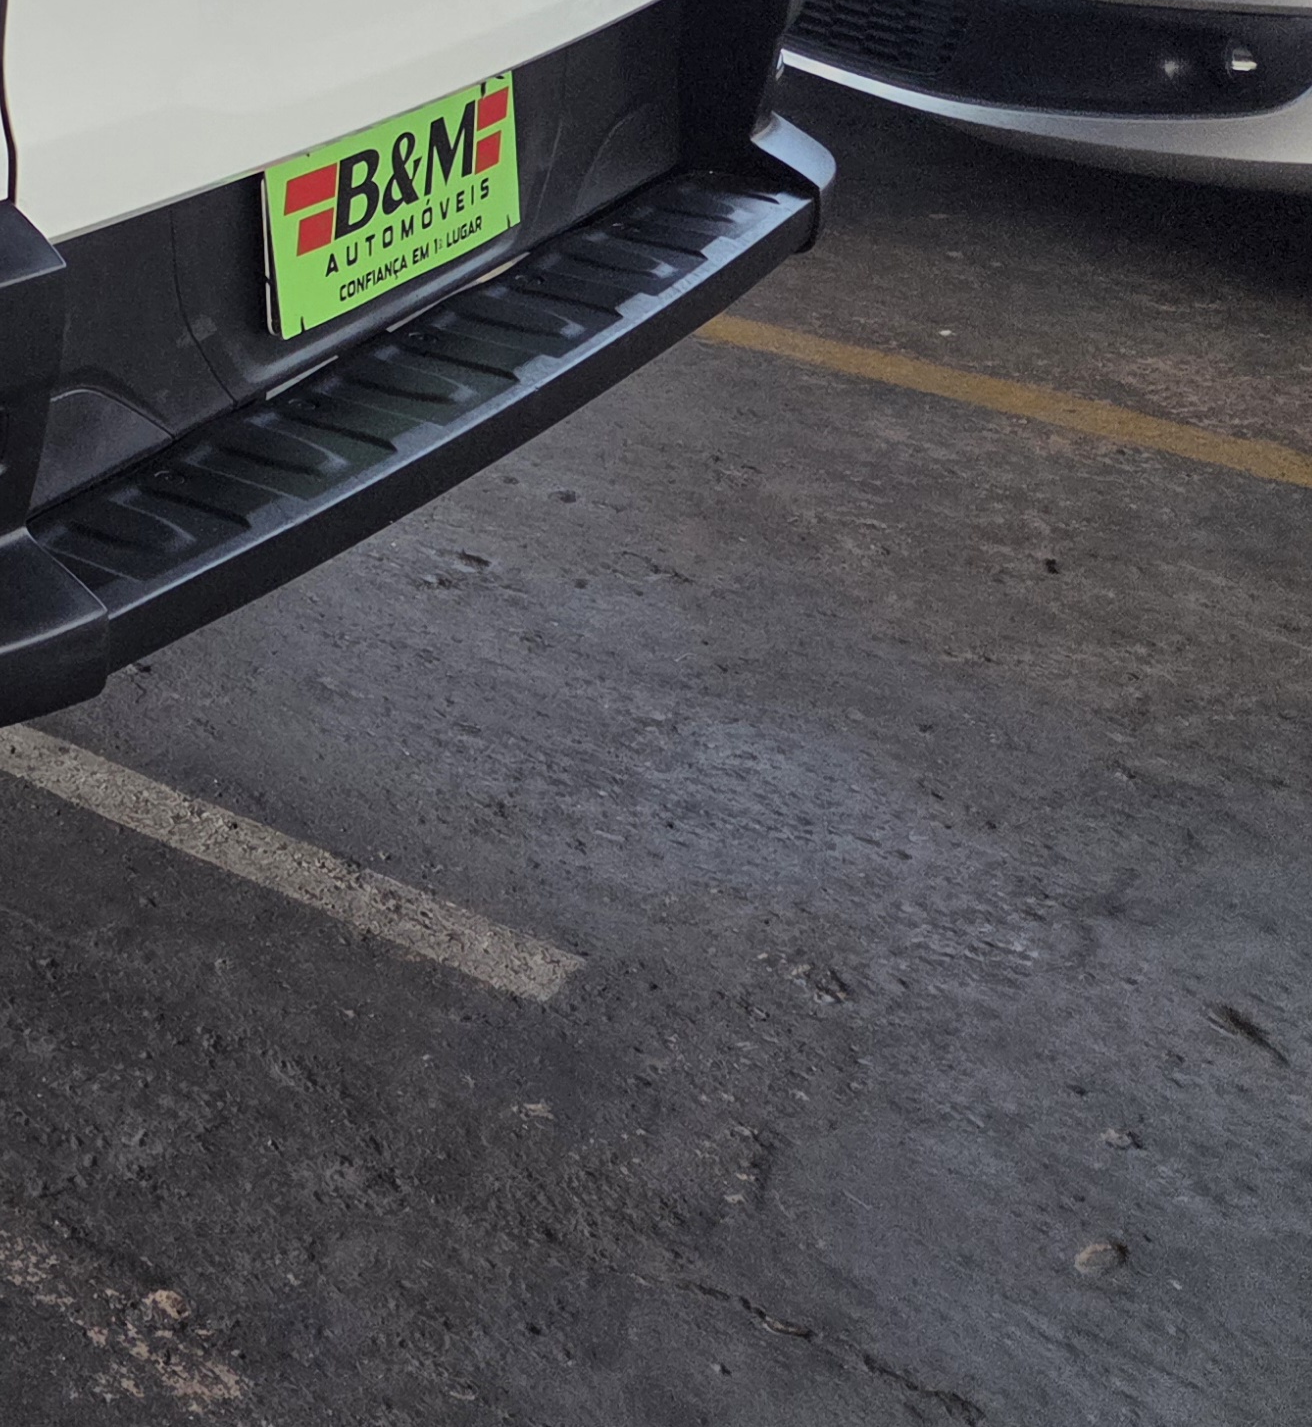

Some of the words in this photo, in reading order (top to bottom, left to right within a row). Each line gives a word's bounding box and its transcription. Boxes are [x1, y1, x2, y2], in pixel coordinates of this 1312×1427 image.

[334, 99, 476, 241] B&M
[325, 177, 490, 277] AUTOMÓVEIS
[339, 258, 408, 302] CONFIANÇA
[412, 242, 429, 265] EM
[447, 215, 482, 248] LUGAR
